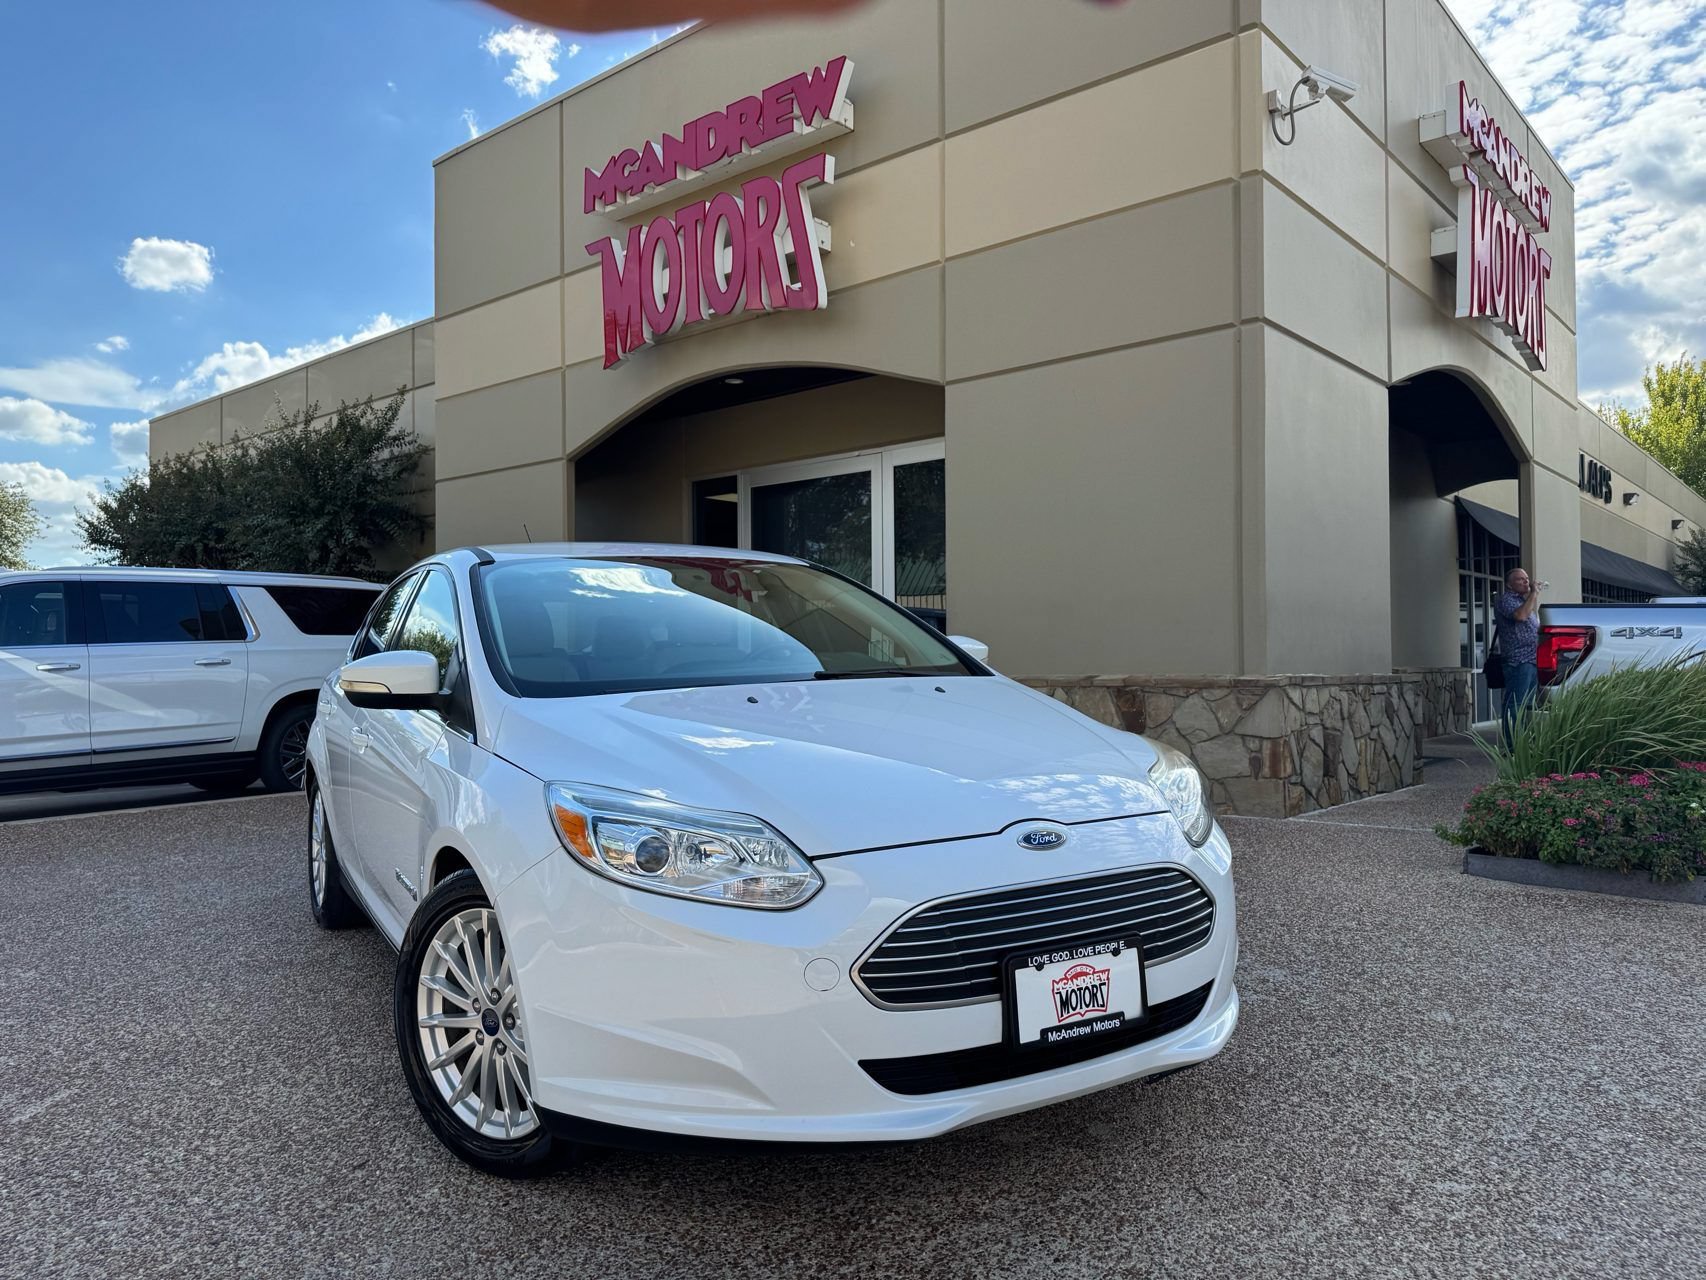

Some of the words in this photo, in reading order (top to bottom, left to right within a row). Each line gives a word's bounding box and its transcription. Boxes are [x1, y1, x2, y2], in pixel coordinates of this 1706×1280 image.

[585, 152, 828, 370] MOTORS
[1462, 163, 1552, 372] MOTORS
[1030, 832, 1058, 845] Ford
[1028, 954, 1050, 967] LOVE
[1051, 951, 1072, 962] GOD.
[1073, 946, 1095, 958] LOVE
[1055, 982, 1106, 1018] MOTORS
[1048, 1025, 1091, 1042] McAndrew
[1092, 1019, 1121, 1032] Motors
